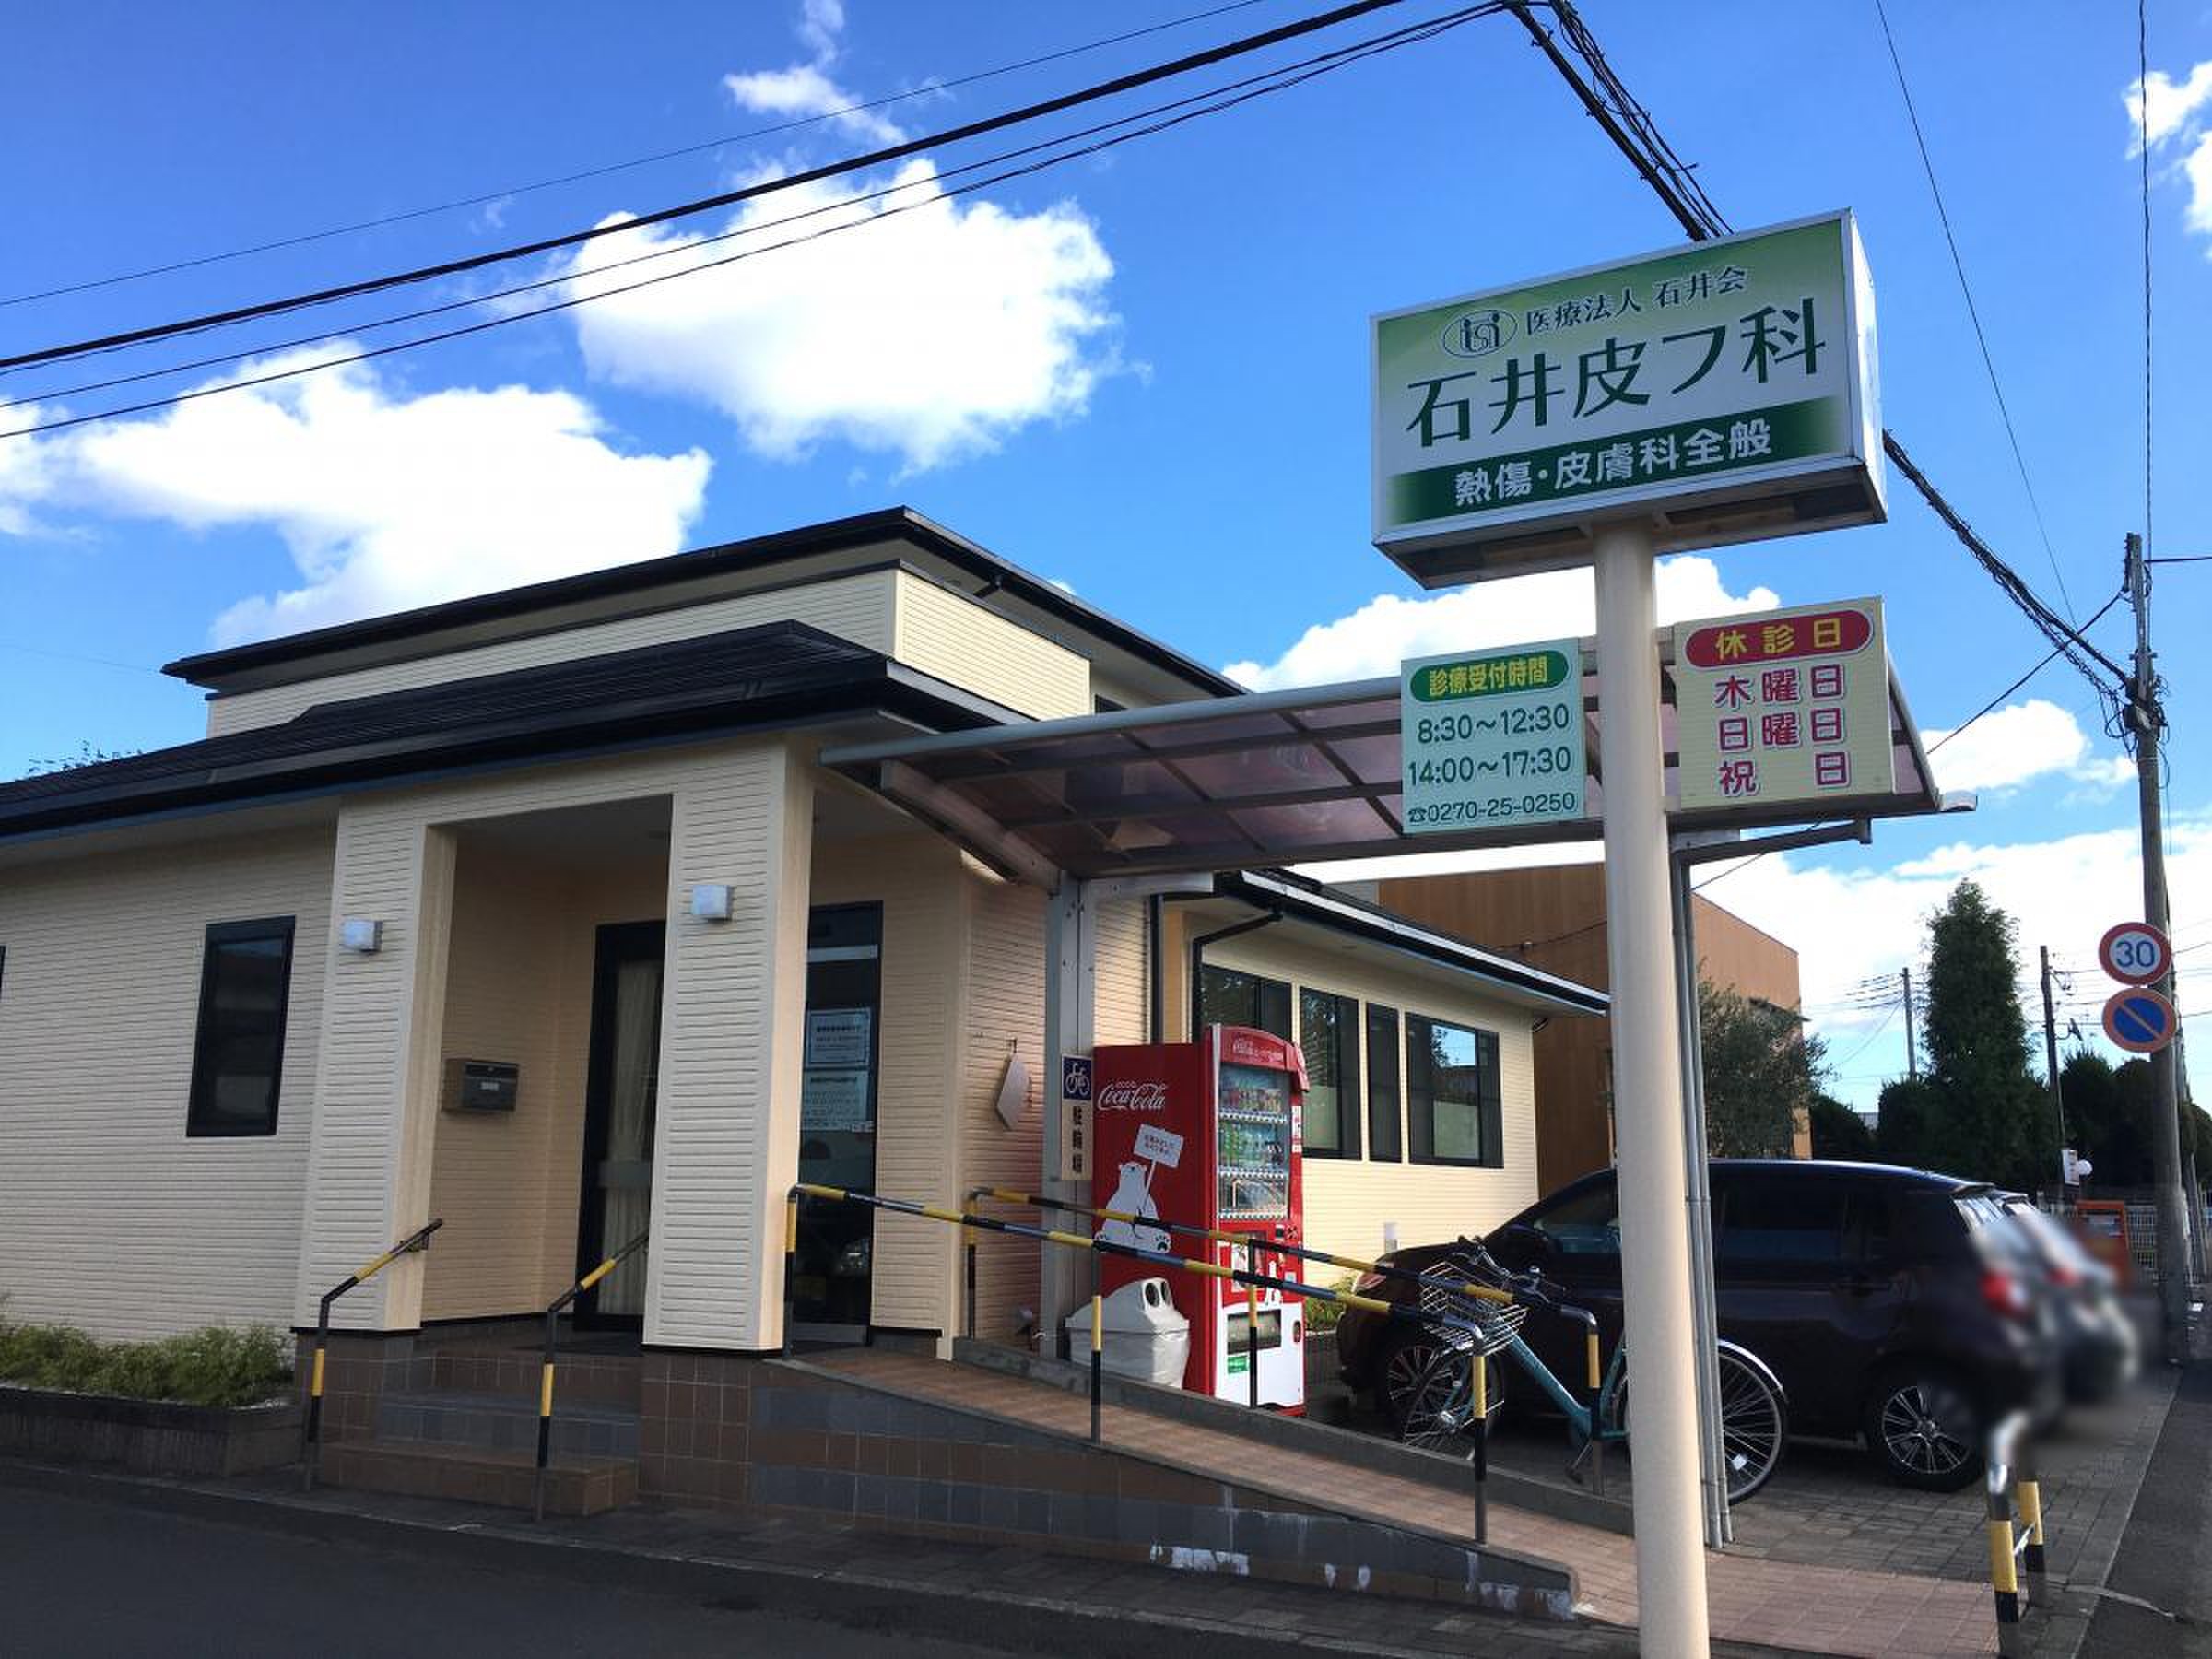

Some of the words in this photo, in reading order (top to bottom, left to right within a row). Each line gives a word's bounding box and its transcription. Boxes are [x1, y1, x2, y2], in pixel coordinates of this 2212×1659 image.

[1526, 288, 1641, 335] 医療法人
[1654, 266, 1747, 308] 石井会
[1406, 298, 1826, 448] 石井皮フ科
[1454, 418, 1772, 507] 熱傷・皮膚科全般
[1715, 618, 1841, 661] 休診日
[1429, 655, 1548, 697] 診療受付時間
[1713, 663, 1844, 708] 木曜日
[1718, 707, 1843, 751] 日曜日
[2115, 939, 2155, 968] 30
